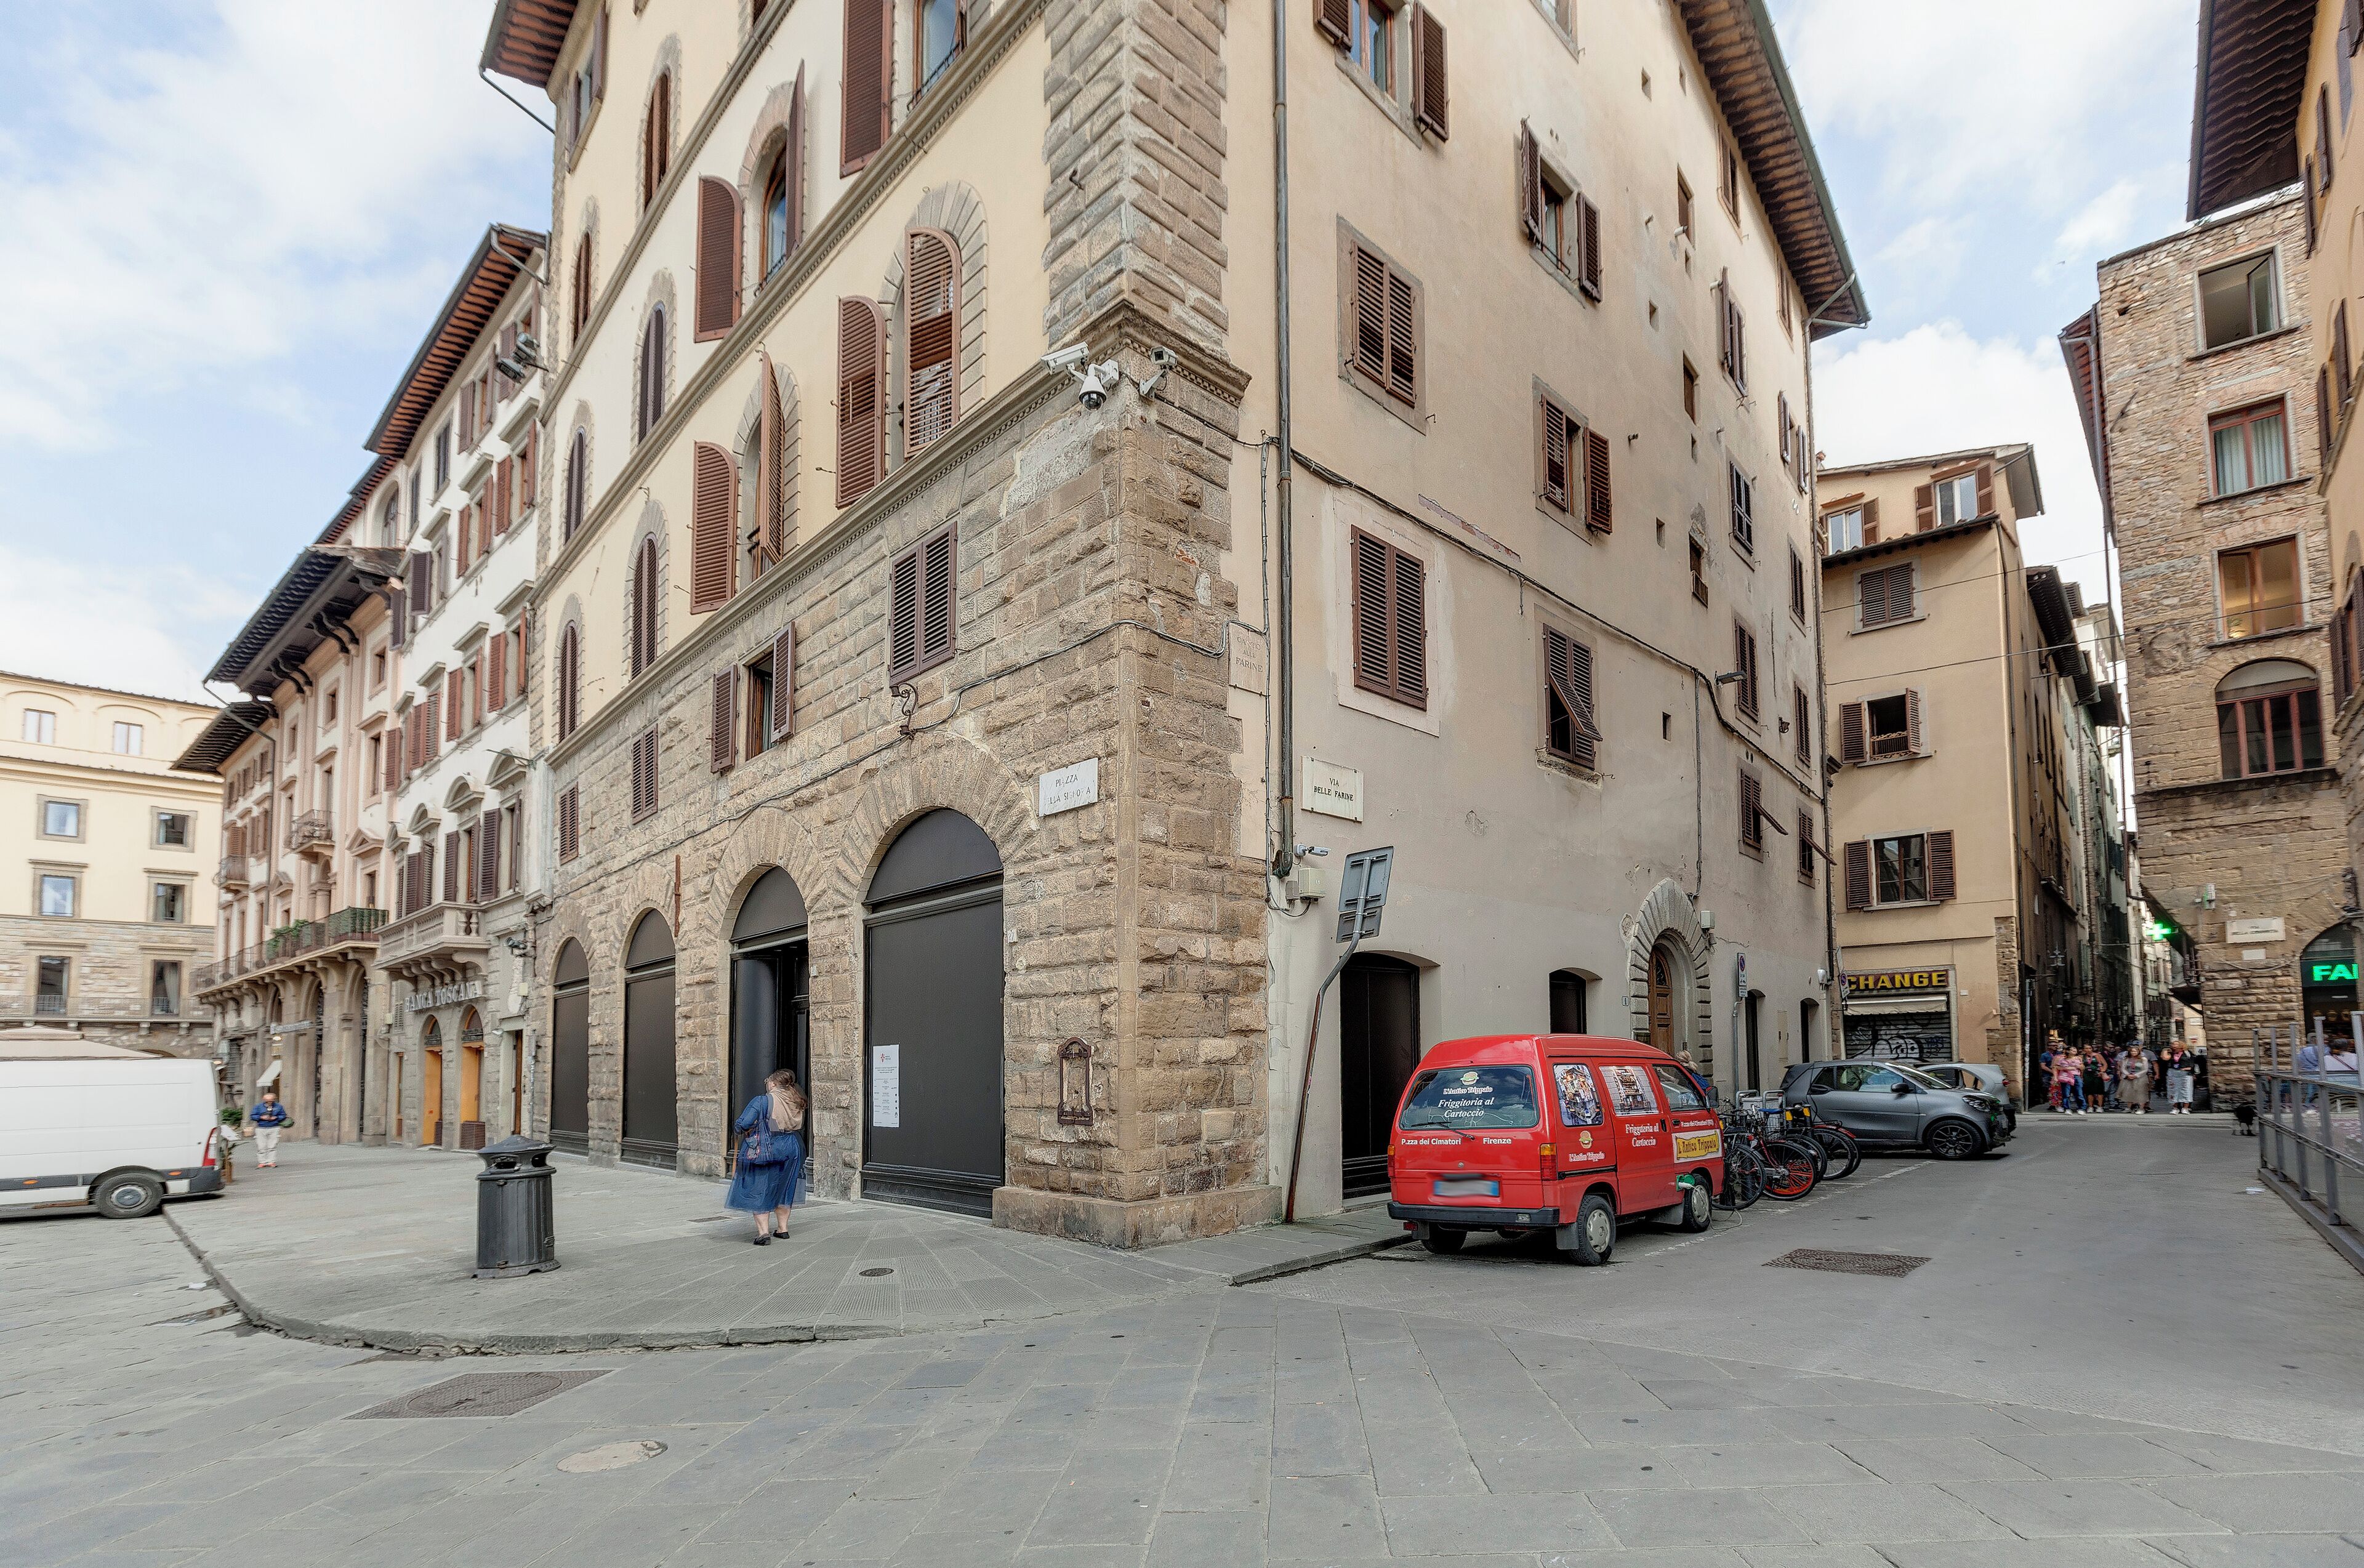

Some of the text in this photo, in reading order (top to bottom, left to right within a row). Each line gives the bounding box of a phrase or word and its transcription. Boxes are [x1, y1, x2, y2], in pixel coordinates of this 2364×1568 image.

[1236, 657, 1263, 672] FARINE
[1329, 778, 1340, 787] VIA
[1314, 786, 1354, 802] DELLE FARINE
[404, 981, 481, 1011] BANCA TOSCANA
[1467, 1086, 1493, 1095] Trippaio
[1437, 1097, 1495, 1109] Friggitoria al
[1444, 1108, 1484, 1118] Cartoccio
